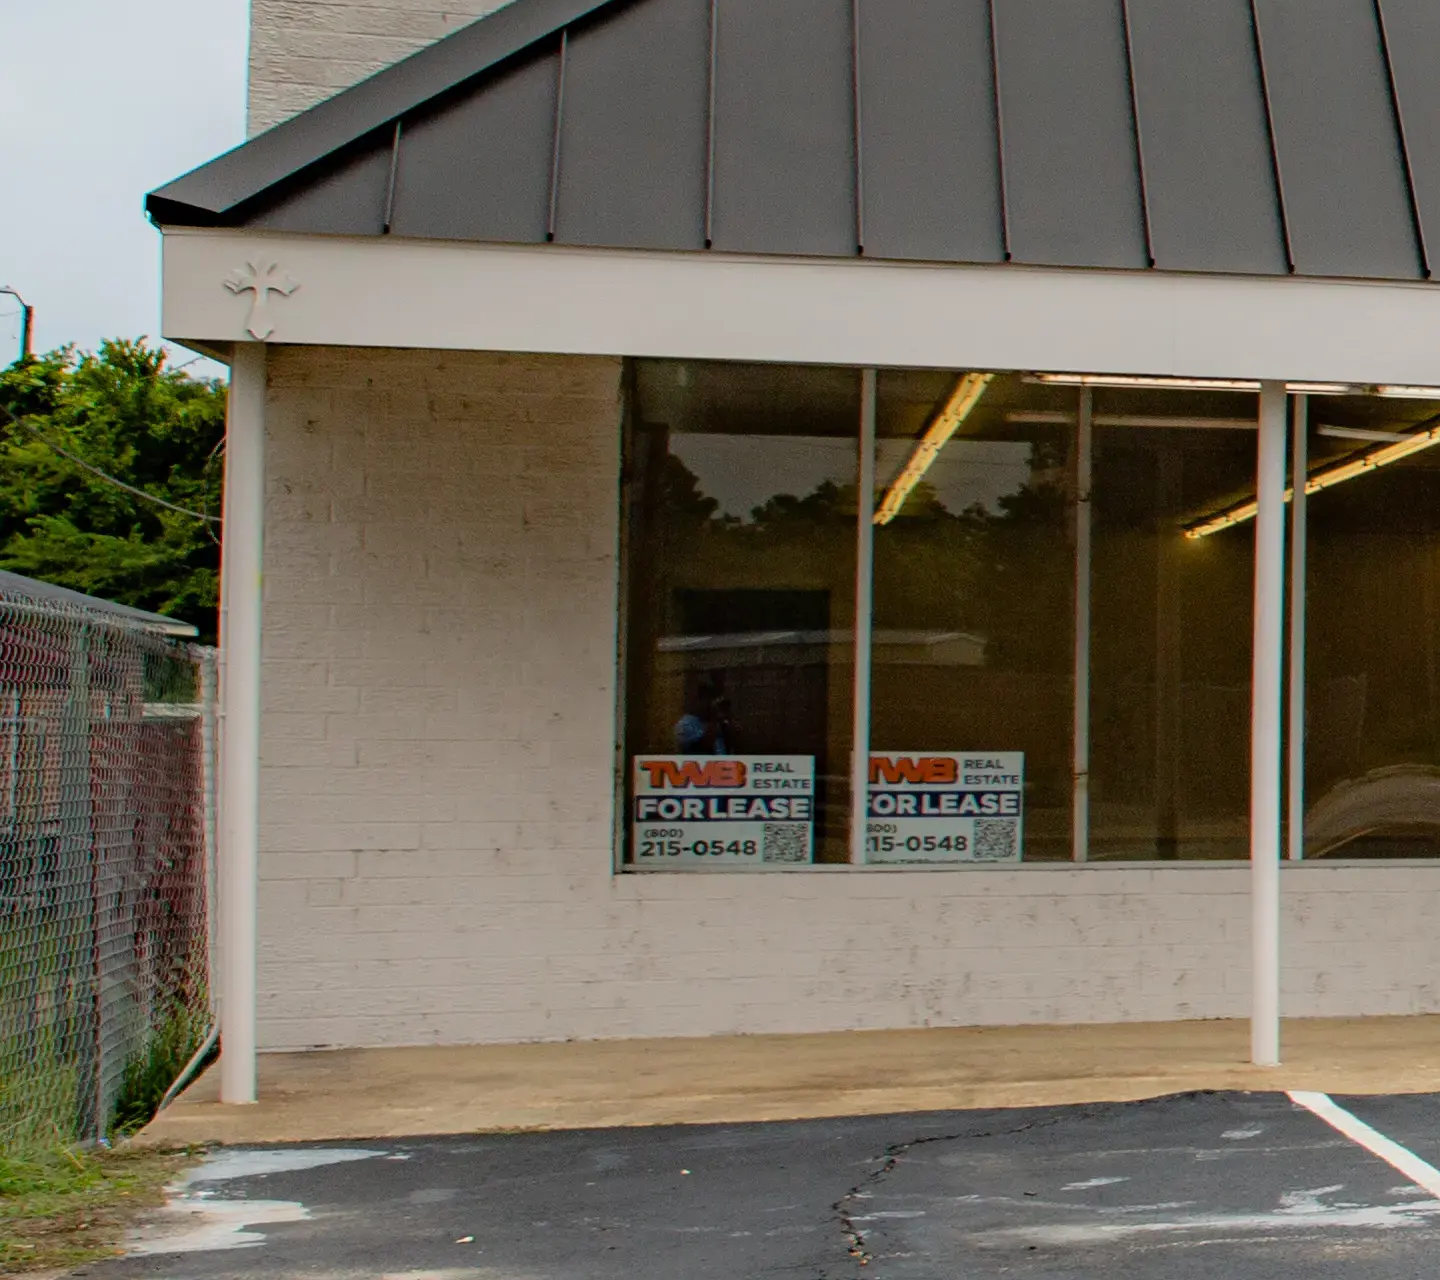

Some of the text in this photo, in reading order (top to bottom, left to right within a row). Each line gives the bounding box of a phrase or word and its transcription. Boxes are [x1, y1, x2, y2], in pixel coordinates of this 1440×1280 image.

[752, 762, 794, 773] REAL
[963, 758, 1004, 770] REAL
[640, 760, 747, 789] TWB
[963, 774, 1019, 785] ESTATE
[752, 778, 811, 789] ESTATE
[638, 797, 810, 820] FOR LEASE
[868, 793, 1019, 816] OR LEASE
[644, 828, 684, 839] (800)
[640, 840, 757, 857] 215-0548
[867, 835, 968, 852] 15-0548
